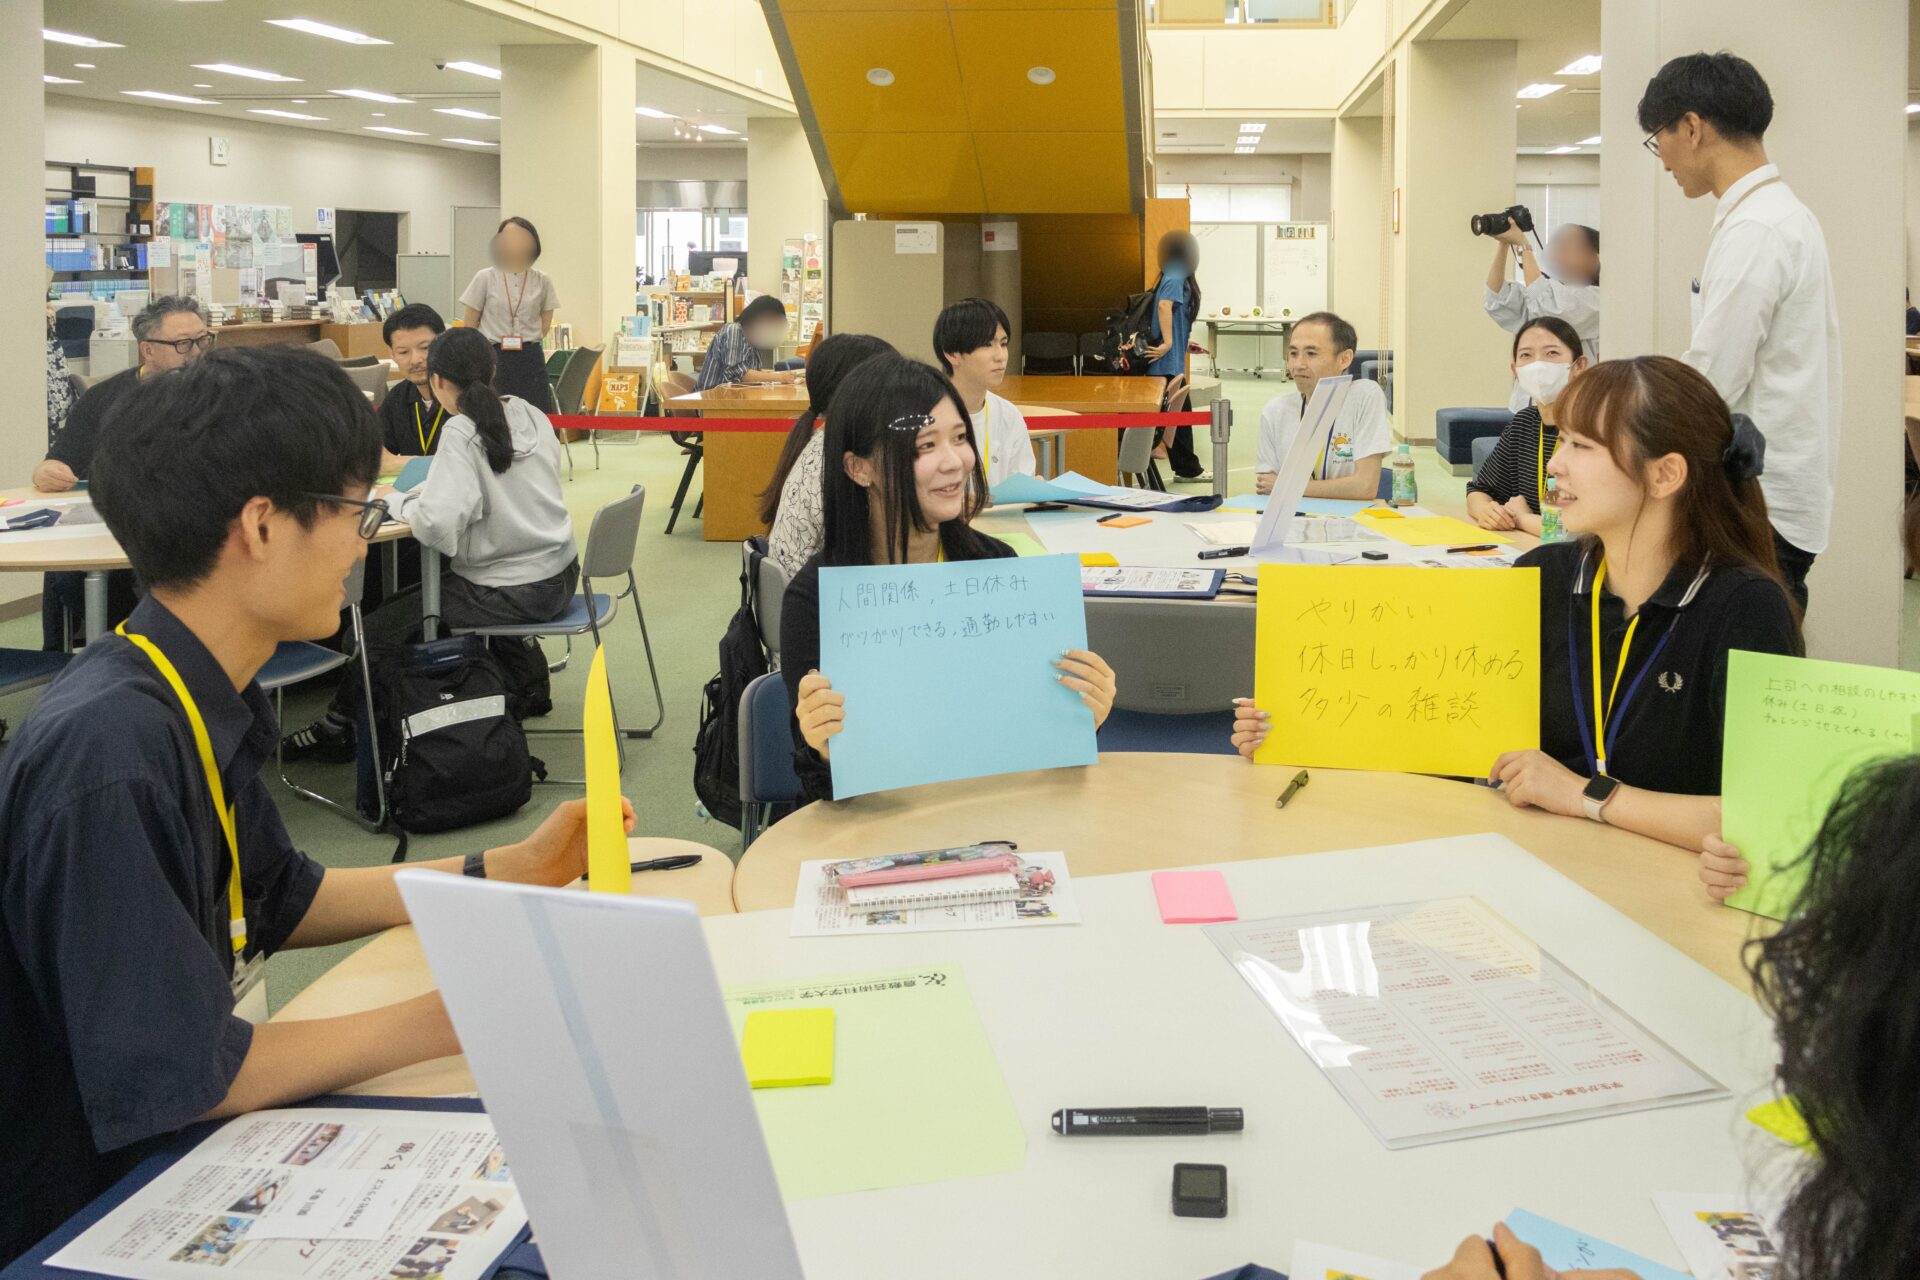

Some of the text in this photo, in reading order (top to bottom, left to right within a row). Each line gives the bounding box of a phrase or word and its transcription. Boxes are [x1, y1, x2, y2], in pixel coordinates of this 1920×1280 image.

[610, 383, 629, 391] MAPS
[1296, 596, 1432, 625] やりがい
[1298, 641, 1524, 680] 休日しっかり休める
[1299, 686, 1481, 729] 多少の雑談
